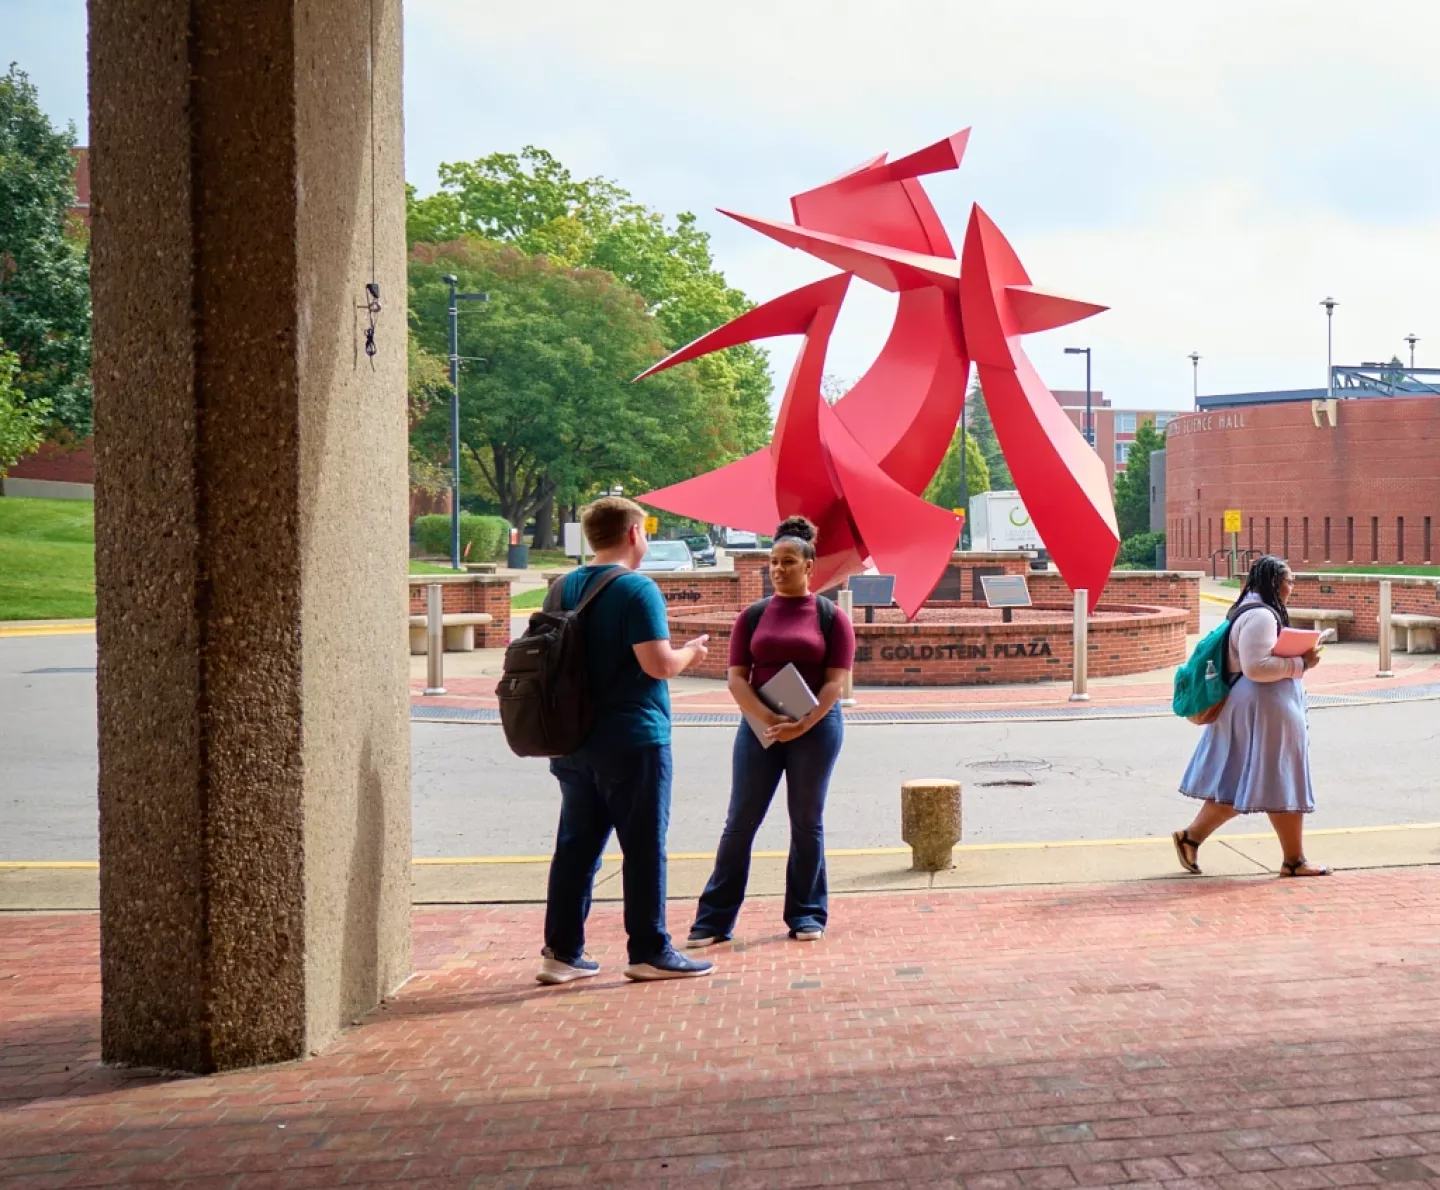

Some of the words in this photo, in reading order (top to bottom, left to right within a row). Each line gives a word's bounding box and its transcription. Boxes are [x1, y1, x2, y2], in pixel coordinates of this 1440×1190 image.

[1218, 412, 1245, 429] HALL
[880, 643, 987, 660] GOLDSTEIN
[994, 641, 1053, 659] PLAZA
